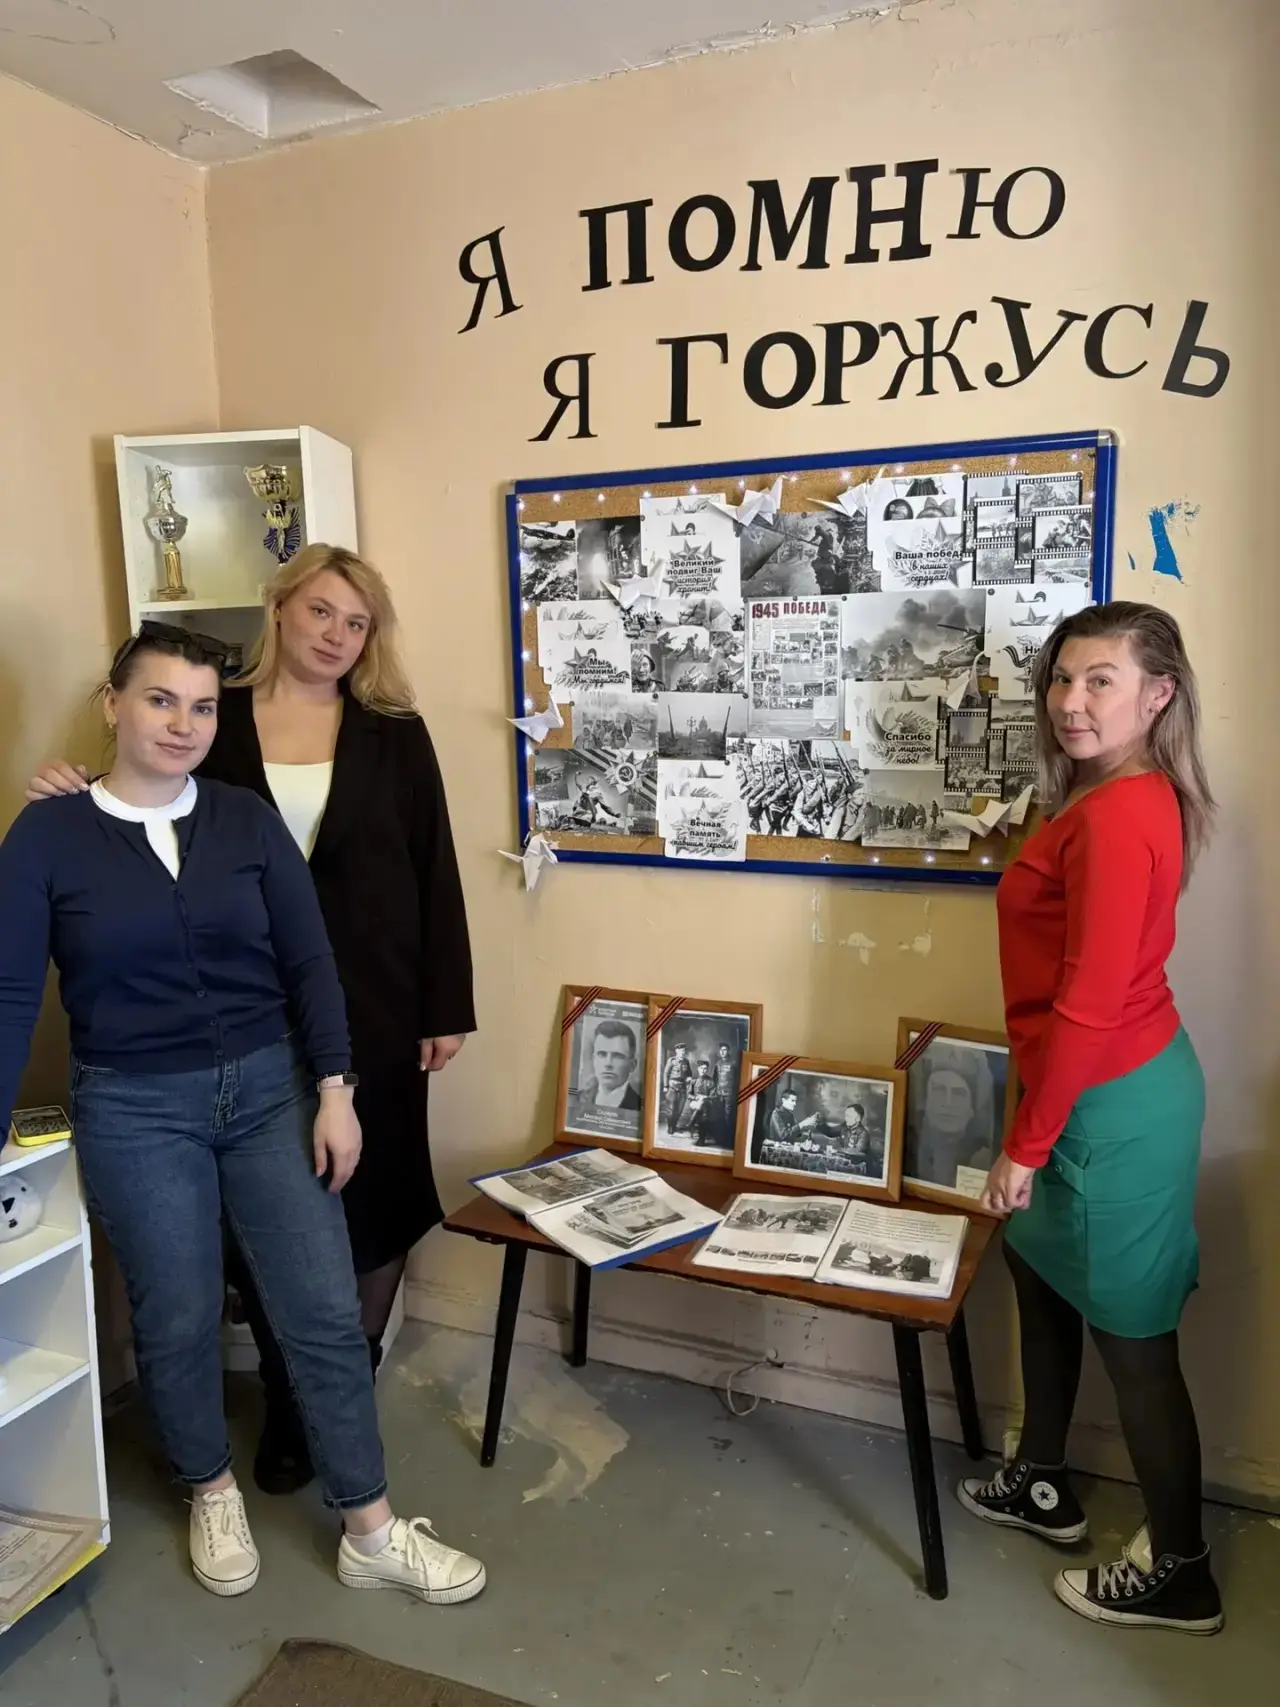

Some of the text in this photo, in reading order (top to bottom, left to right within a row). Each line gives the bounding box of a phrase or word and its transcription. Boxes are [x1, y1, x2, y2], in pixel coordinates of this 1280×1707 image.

[457, 158, 1067, 334] Я ПОМНЮ
[527, 296, 1231, 442] Я ГОРЖУСЬ
[895, 551, 923, 560] Ваша
[751, 601, 827, 619] 1945 ПОБЕДА
[589, 657, 605, 666] Мы
[578, 666, 617, 675] помним!
[885, 732, 931, 741] Спасибо
[896, 754, 920, 764] небо!
[690, 819, 722, 828] Вечная
[689, 830, 721, 838] память
